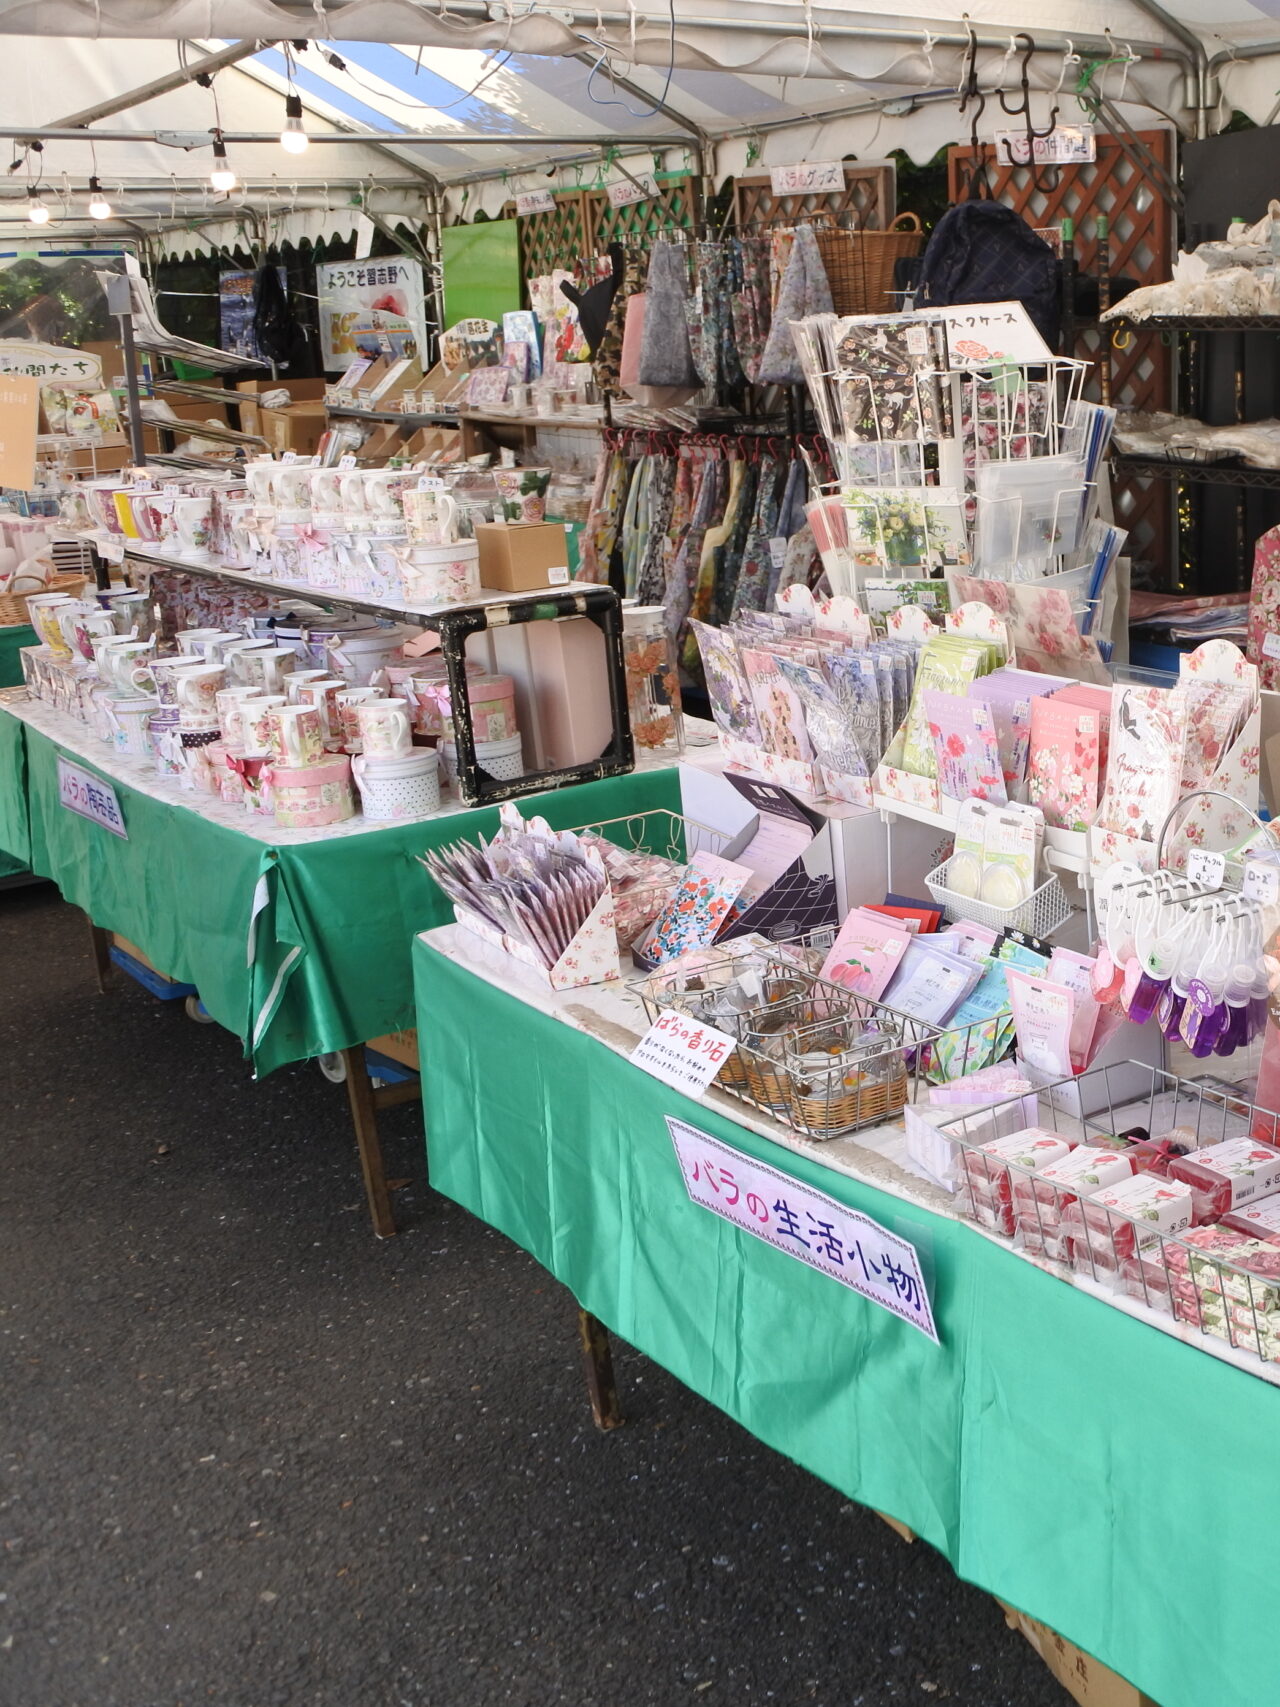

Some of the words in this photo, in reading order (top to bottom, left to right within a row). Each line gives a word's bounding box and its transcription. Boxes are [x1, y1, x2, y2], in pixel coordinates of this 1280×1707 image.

[328, 265, 410, 290] ようこそ習志野へ
[655, 1016, 727, 1063] ばらの香り石
[691, 1159, 922, 1313] バラの生活小物
